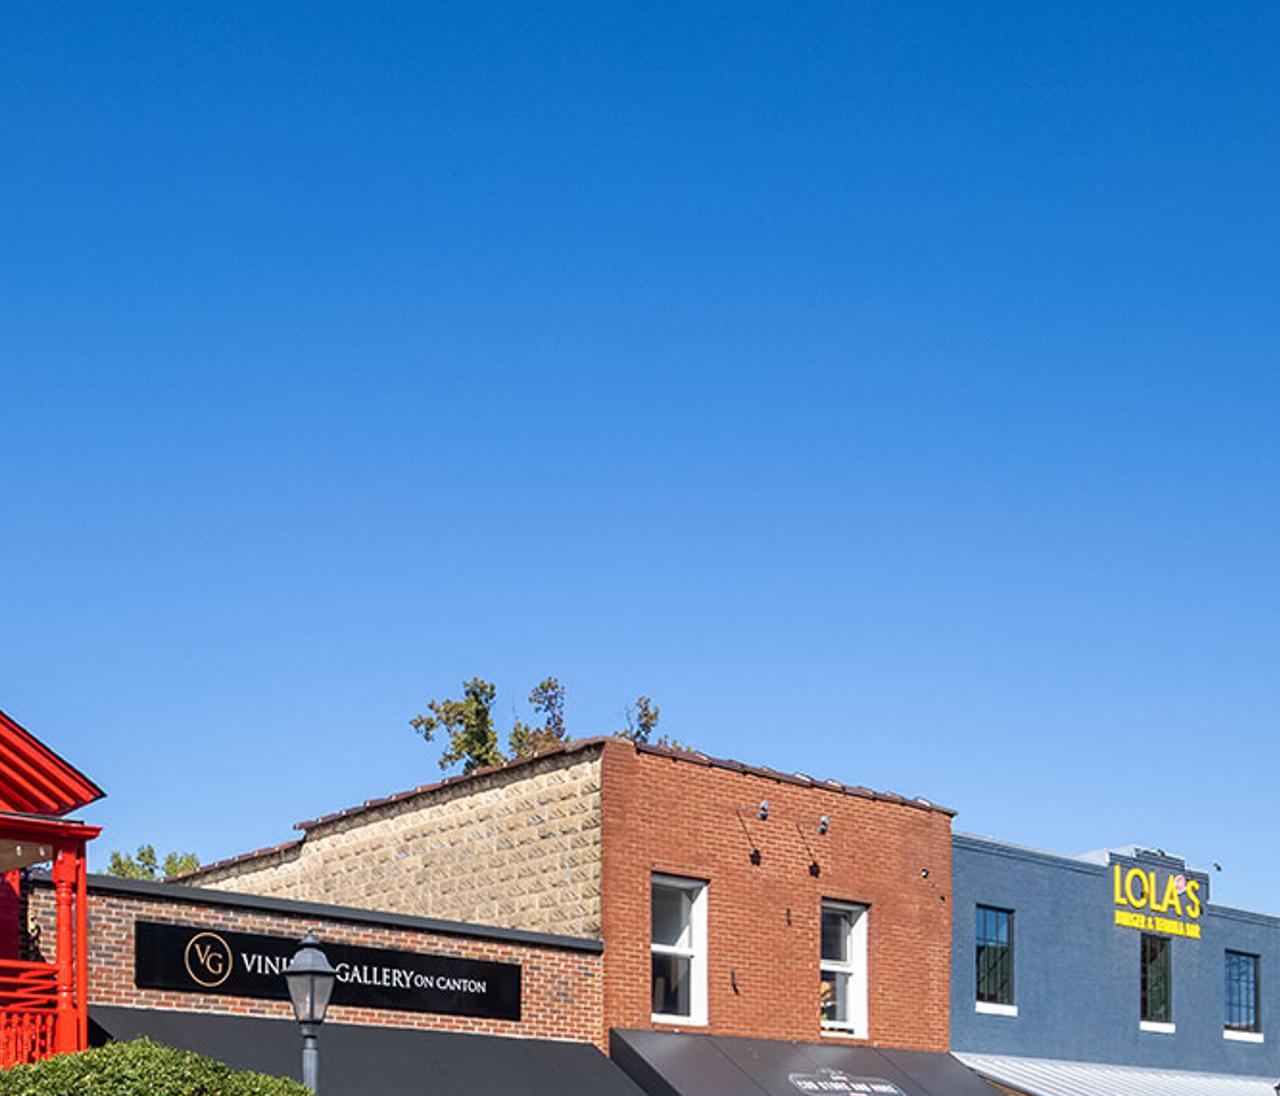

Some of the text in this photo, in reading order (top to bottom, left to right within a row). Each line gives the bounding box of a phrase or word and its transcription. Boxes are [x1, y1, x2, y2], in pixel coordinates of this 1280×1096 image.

[194, 943, 223, 974] VG
[336, 963, 414, 988] GALLERY
[414, 974, 434, 988] ON
[436, 976, 487, 993] CANTON
